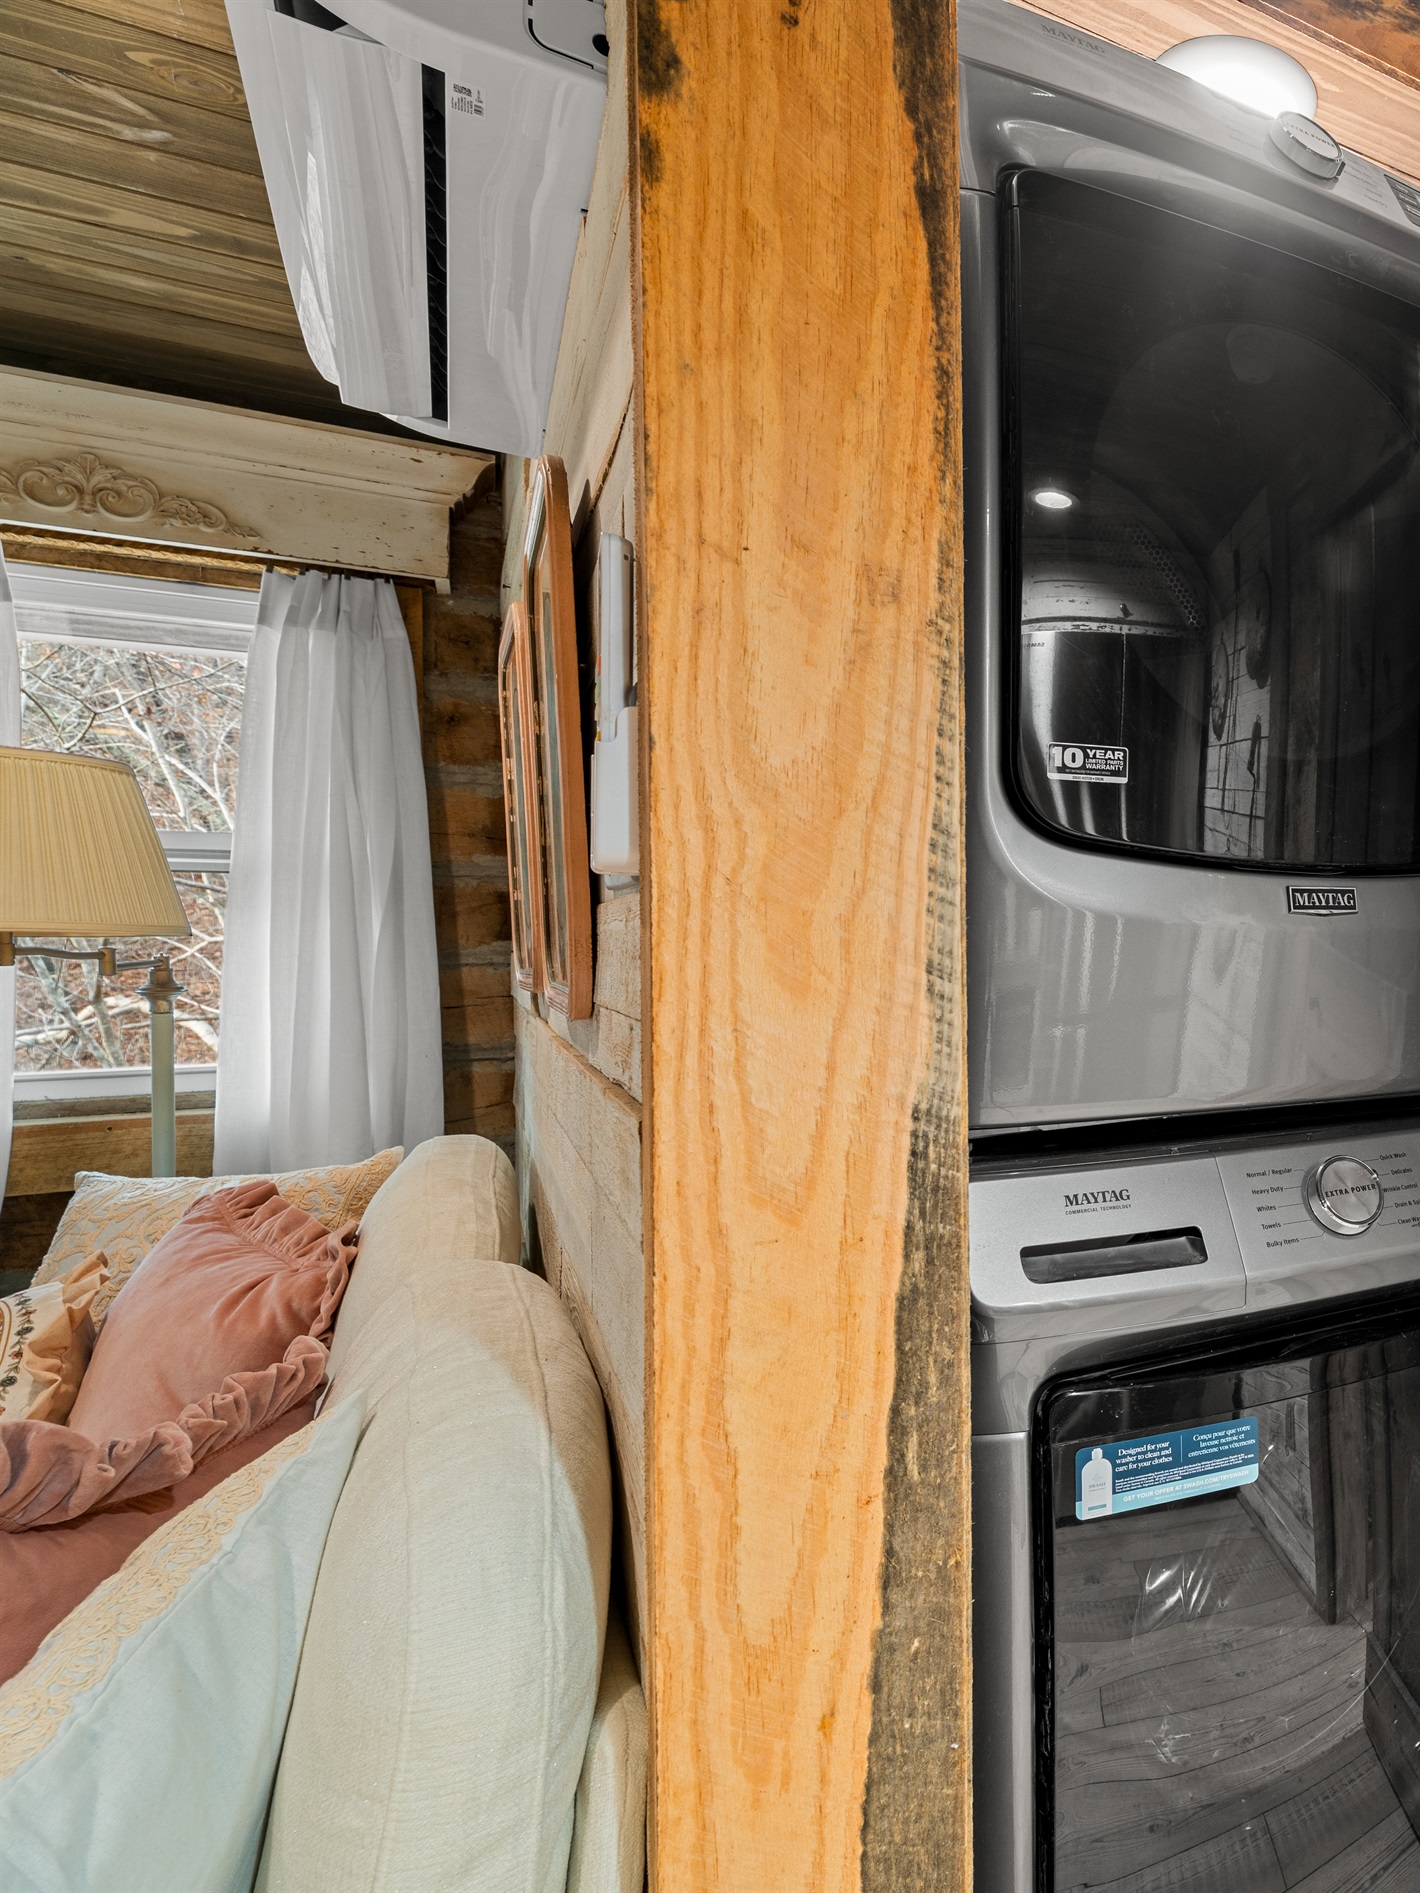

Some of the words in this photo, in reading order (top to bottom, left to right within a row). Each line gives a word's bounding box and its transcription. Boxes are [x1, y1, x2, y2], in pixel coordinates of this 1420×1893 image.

[1041, 24, 1106, 54] MAYTAG
[1052, 746, 1084, 768] 10
[1086, 749, 1124, 760] YEAR
[1086, 763, 1124, 771] WARRANTY
[1294, 892, 1354, 906] MAYTAG
[1064, 1188, 1130, 1208] MAYTAG
[1325, 1188, 1349, 1198] EXTRA
[1351, 1184, 1376, 1193] POWER
[1200, 1439, 1220, 1448] laveuse
[1220, 1435, 1238, 1443] nettoie
[1213, 1431, 1226, 1439] pour
[1118, 1445, 1146, 1457] Designed
[1156, 1441, 1170, 1450] your
[1188, 1447, 1219, 1458] entretienne
[1116, 1455, 1137, 1464] washer
[1138, 1461, 1151, 1470] your
[1152, 1456, 1172, 1465] clothes
[1136, 1491, 1153, 1499] YOUR
[1154, 1487, 1174, 1496] OFFER
[1183, 1470, 1249, 1489] SWASH.COM/TRYSWASH
